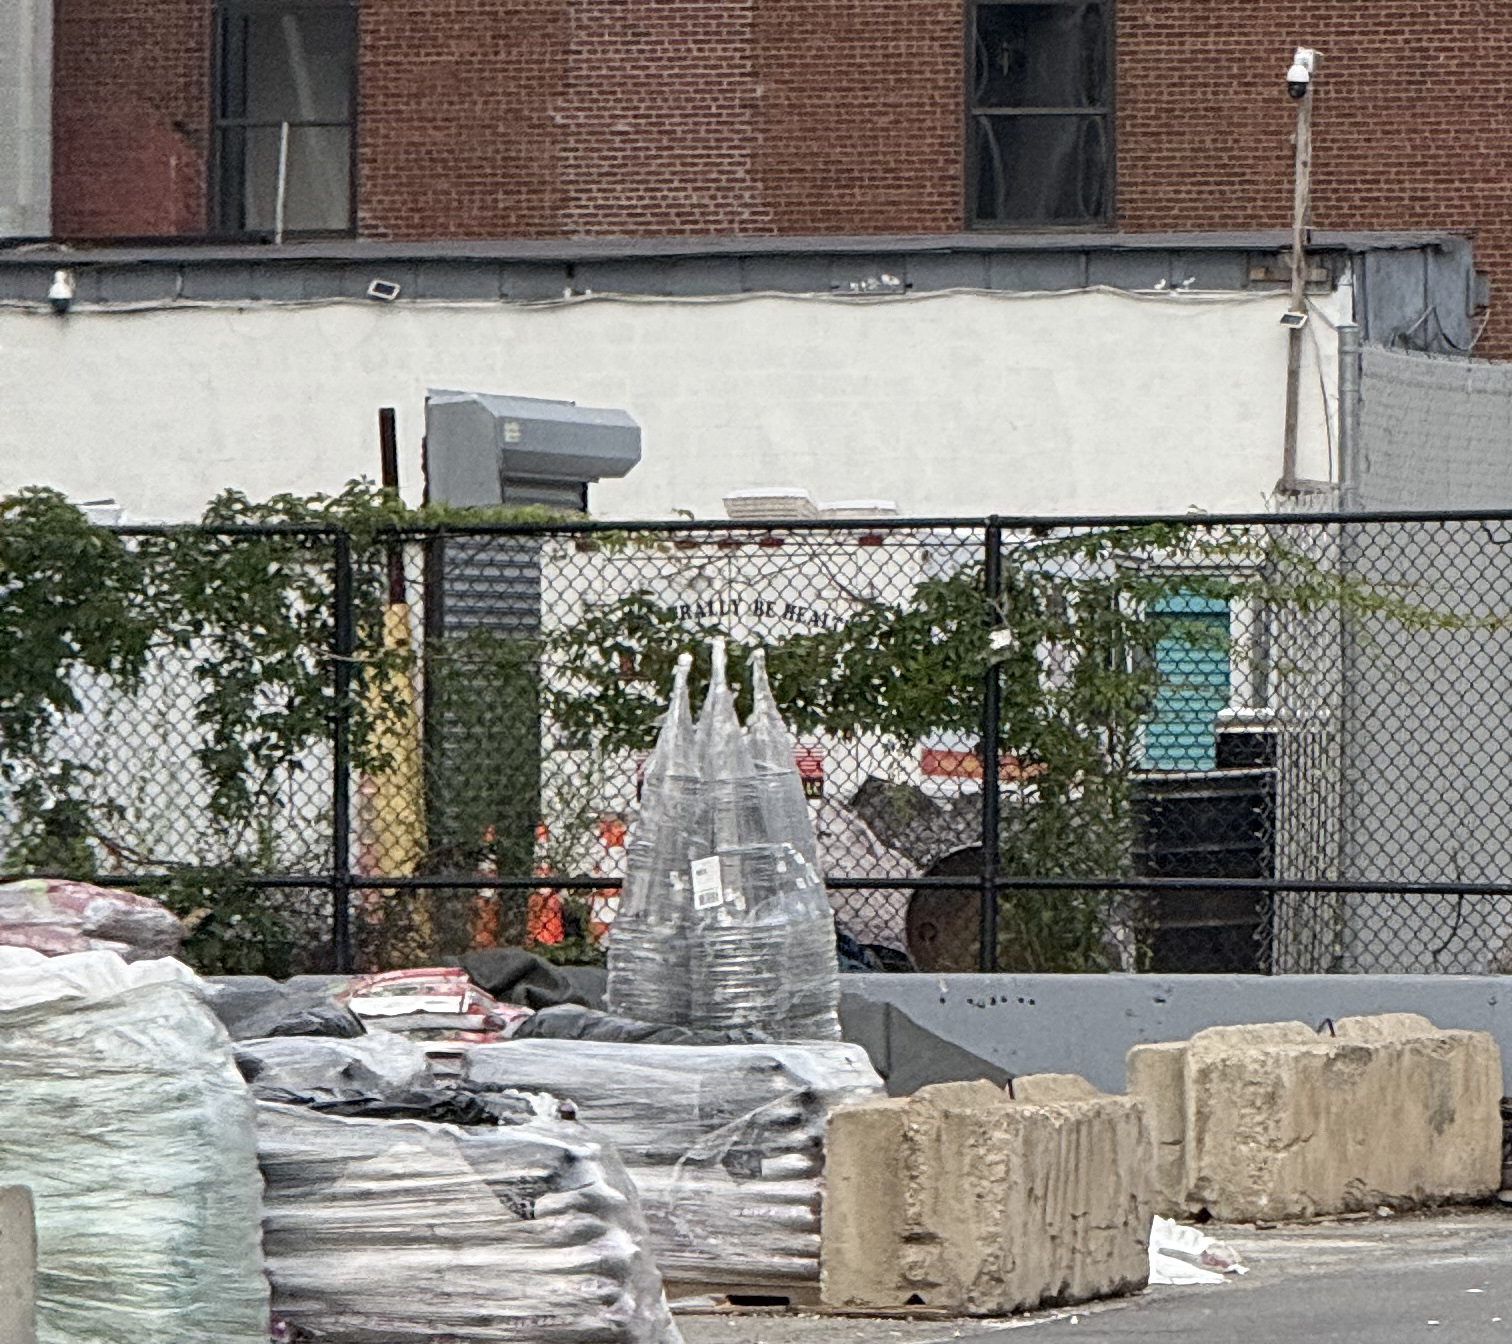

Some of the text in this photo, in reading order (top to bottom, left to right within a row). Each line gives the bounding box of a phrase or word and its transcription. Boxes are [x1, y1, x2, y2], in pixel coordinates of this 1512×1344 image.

[679, 596, 850, 632] RALLY BE HEALT
